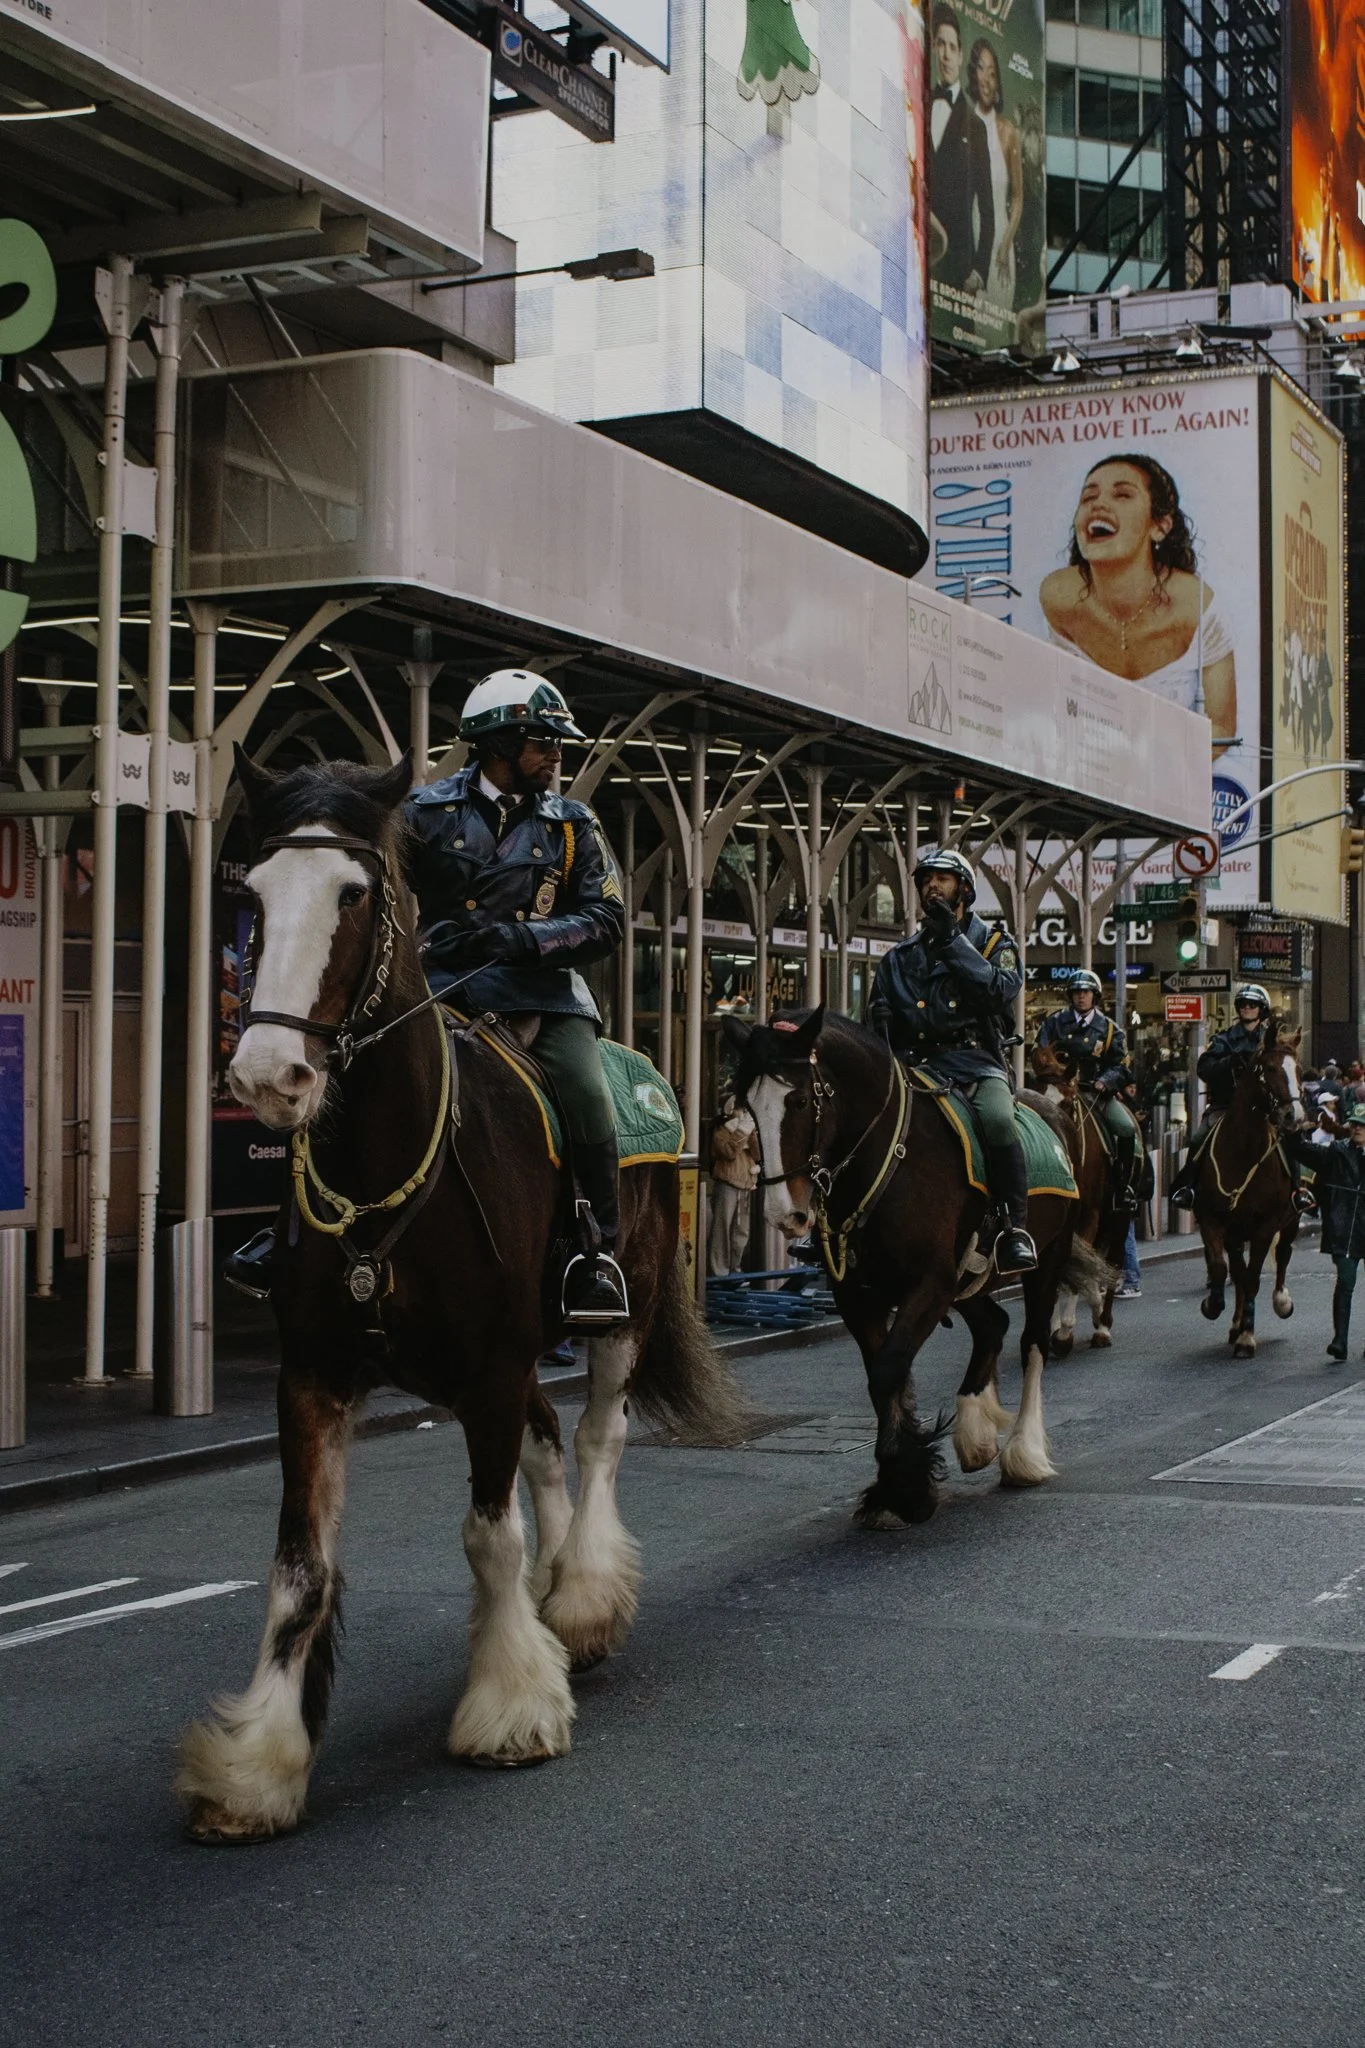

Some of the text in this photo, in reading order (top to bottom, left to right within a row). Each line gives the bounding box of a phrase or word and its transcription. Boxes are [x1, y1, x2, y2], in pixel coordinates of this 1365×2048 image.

[974, 391, 1186, 429] YOU ALREADY KNOW
[992, 424, 1065, 450] GONNA
[1073, 420, 1125, 442] LOVE
[1174, 407, 1249, 432] AGAIN!
[909, 607, 948, 642] ROCK
[220, 861, 249, 881] THE
[1160, 886, 1174, 899] 46
[739, 974, 795, 1000] LUGAGE
[1170, 976, 1221, 987] ONE WAY
